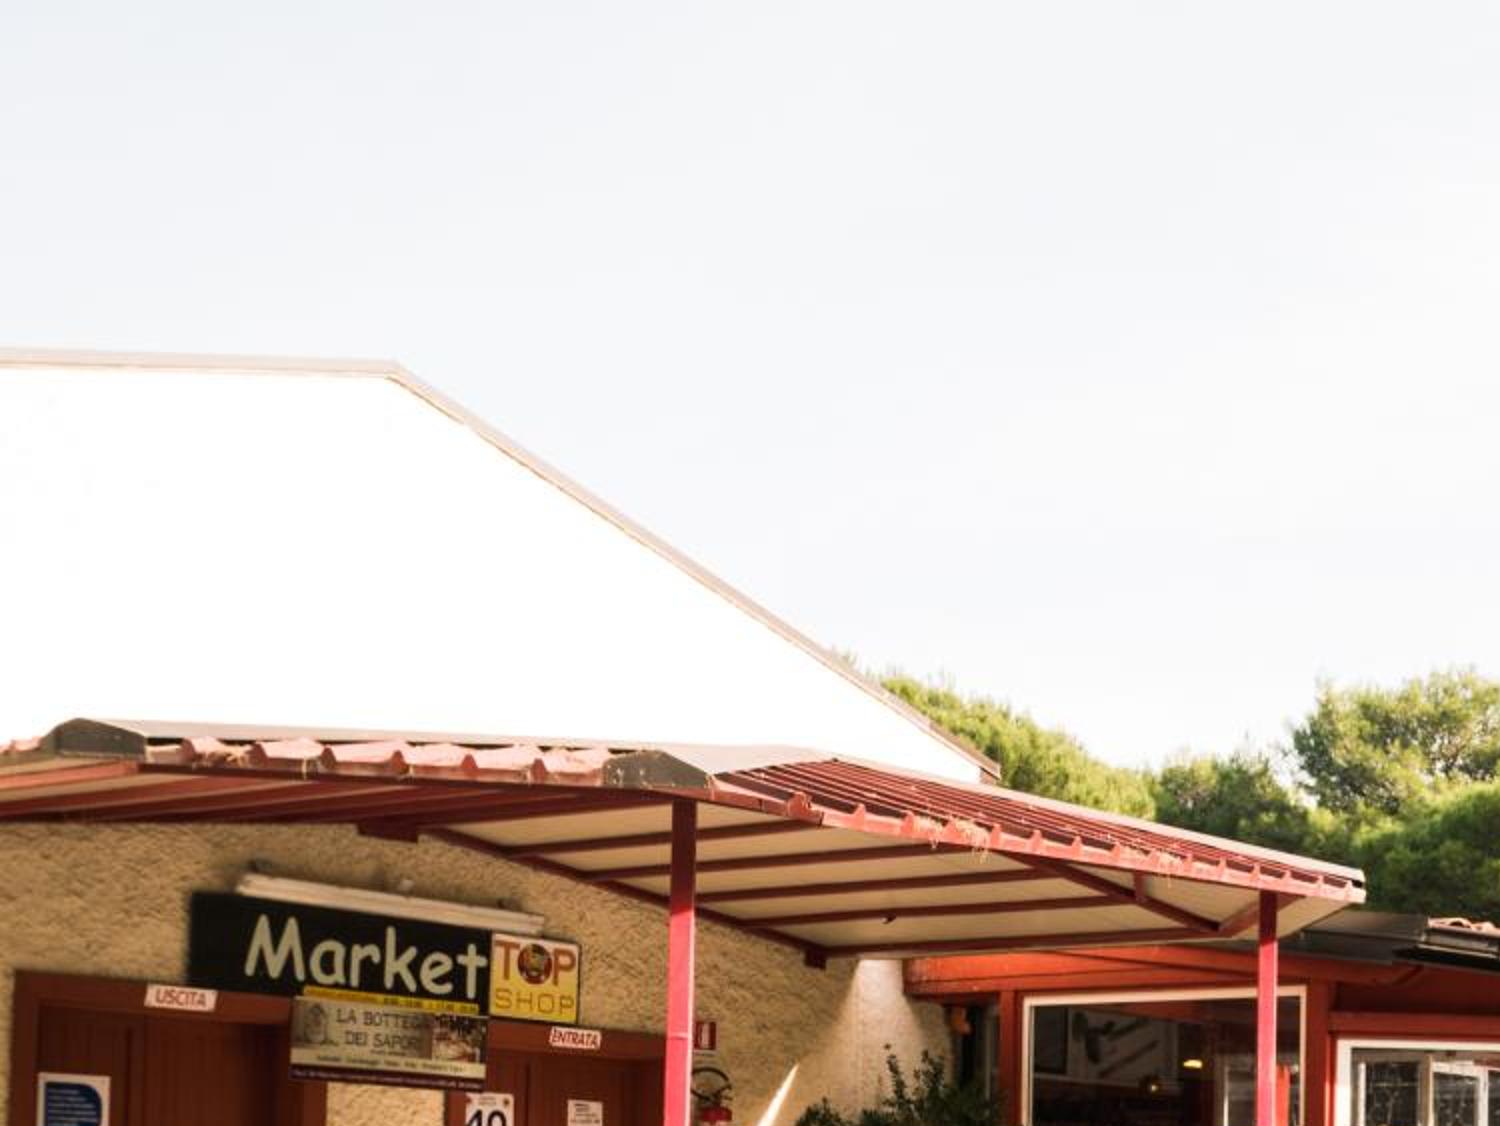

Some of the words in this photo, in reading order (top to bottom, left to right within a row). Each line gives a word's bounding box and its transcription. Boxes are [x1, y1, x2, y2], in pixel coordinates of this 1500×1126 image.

[244, 913, 488, 999] Market
[494, 940, 576, 986] TOP
[155, 988, 207, 1007] USCITA
[494, 987, 575, 1014] SHOP
[336, 1008, 357, 1025] LA
[363, 1010, 431, 1031] BOTTE
[345, 1030, 368, 1046] DEI
[552, 1029, 599, 1048] ENTRATA
